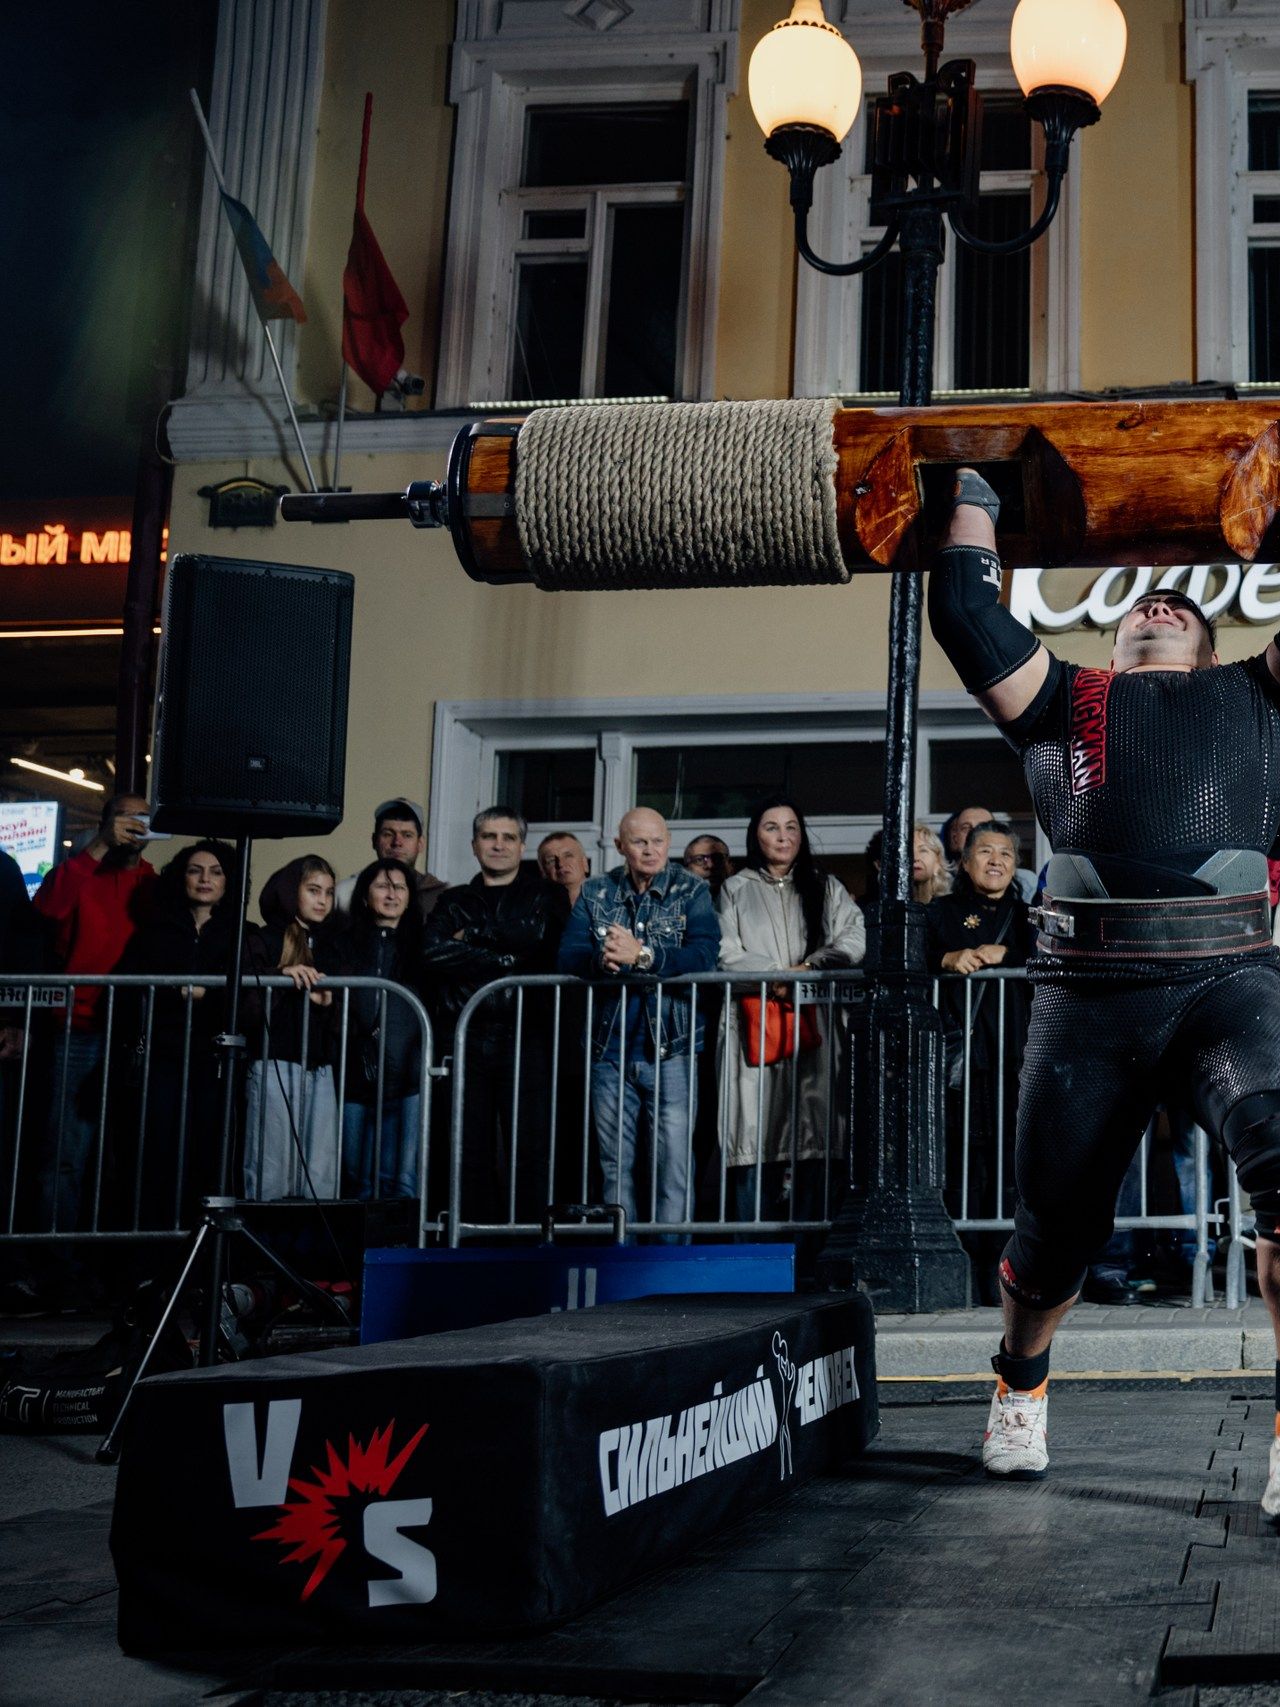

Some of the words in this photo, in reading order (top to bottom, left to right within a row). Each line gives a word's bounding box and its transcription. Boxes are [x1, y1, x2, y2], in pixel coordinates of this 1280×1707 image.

[223, 1398, 302, 1508] V
[363, 1497, 437, 1607] S
[599, 1364, 778, 1518] СИЛЬНЕЙШИЙ
